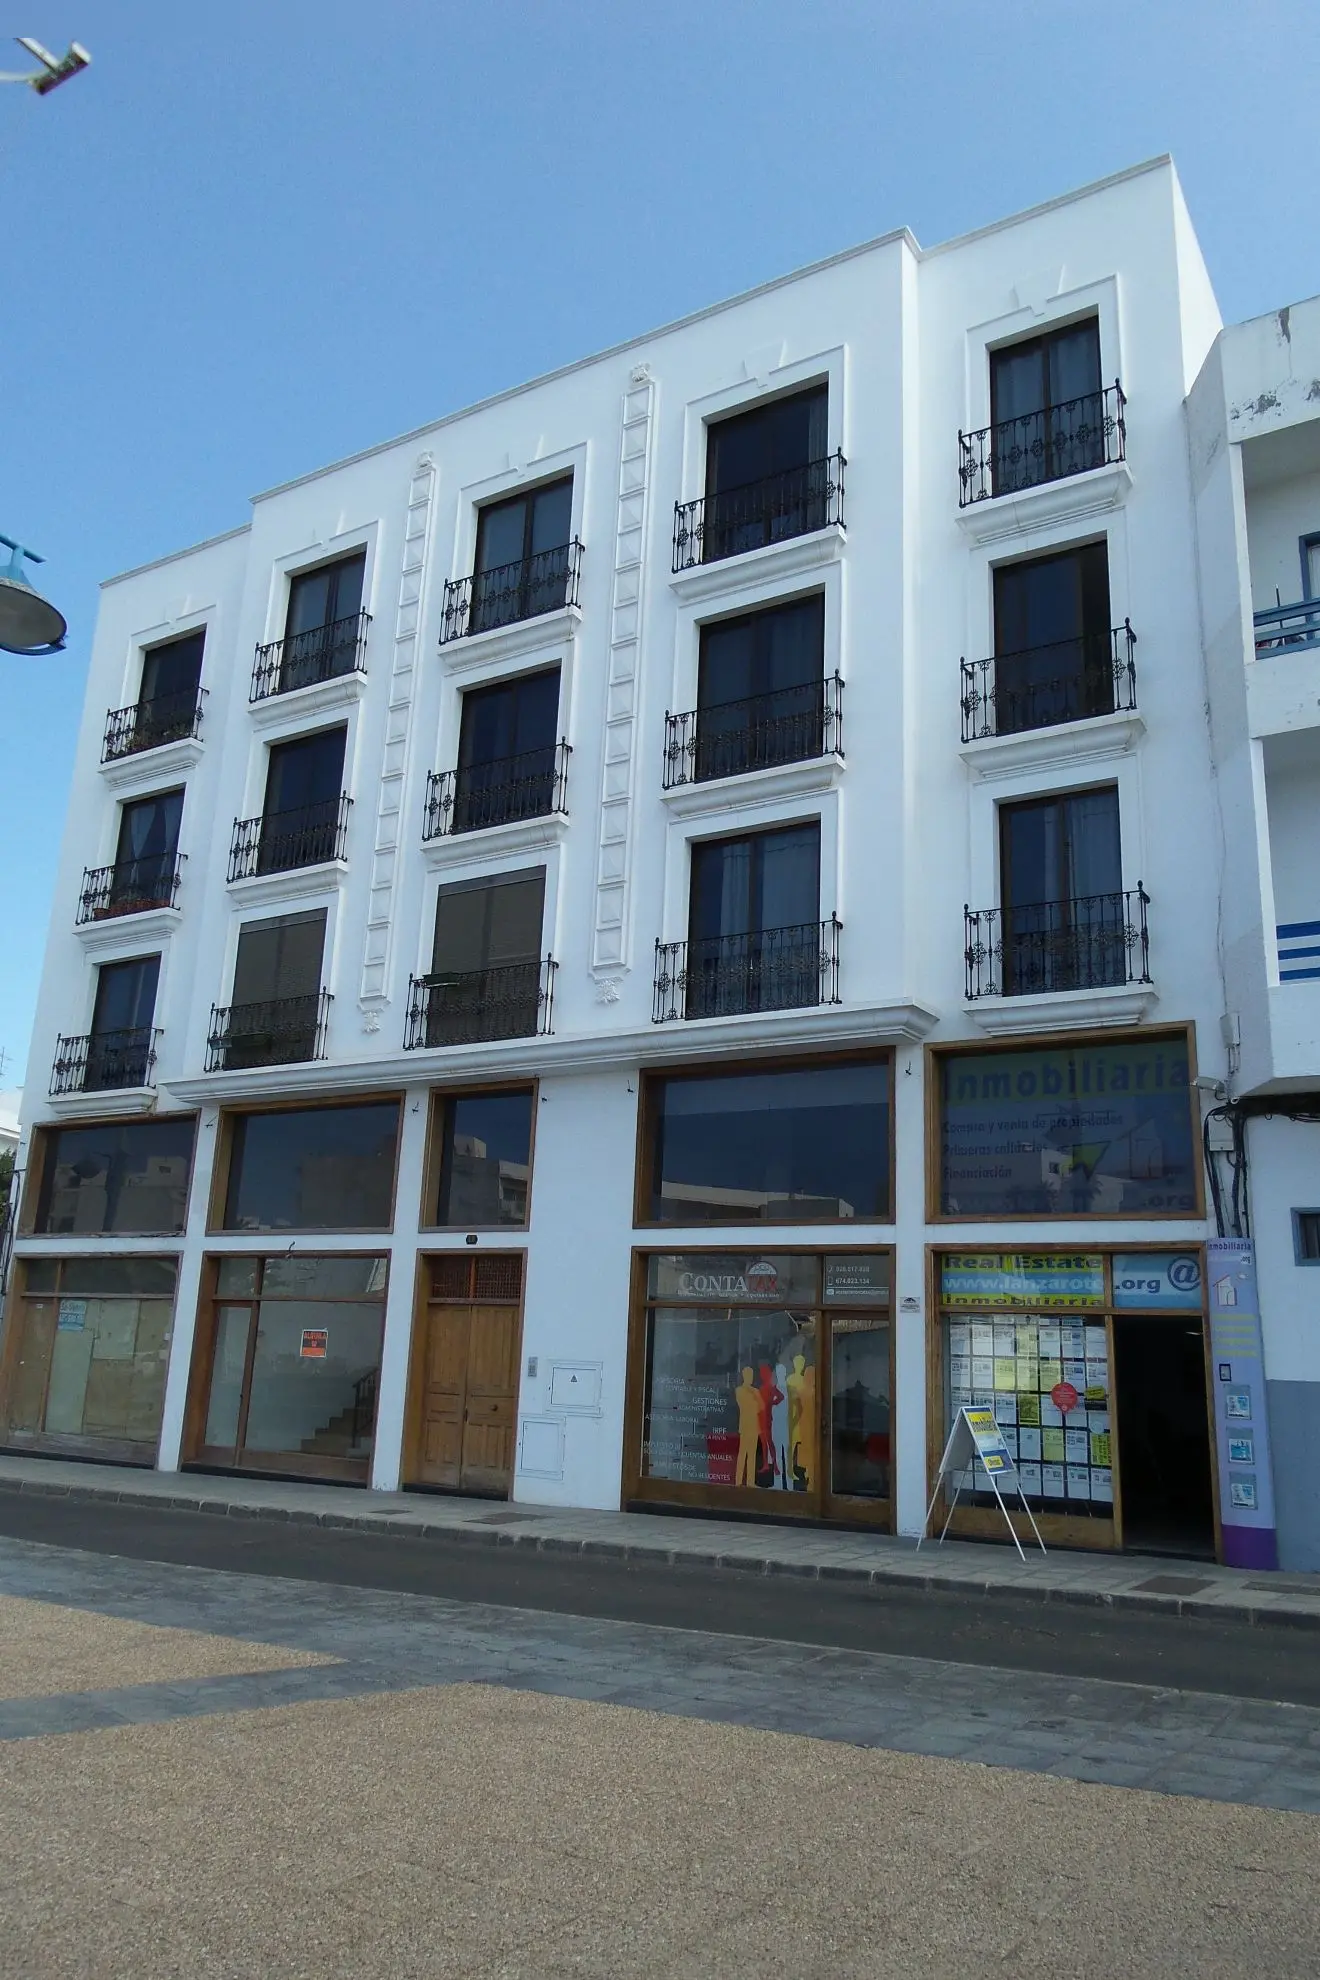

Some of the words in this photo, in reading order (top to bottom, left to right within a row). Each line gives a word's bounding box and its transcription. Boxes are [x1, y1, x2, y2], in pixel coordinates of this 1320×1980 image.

[945, 1255, 1004, 1269] Real
[1014, 1254, 1102, 1269] Estate
[1115, 1275, 1162, 1295] .org
